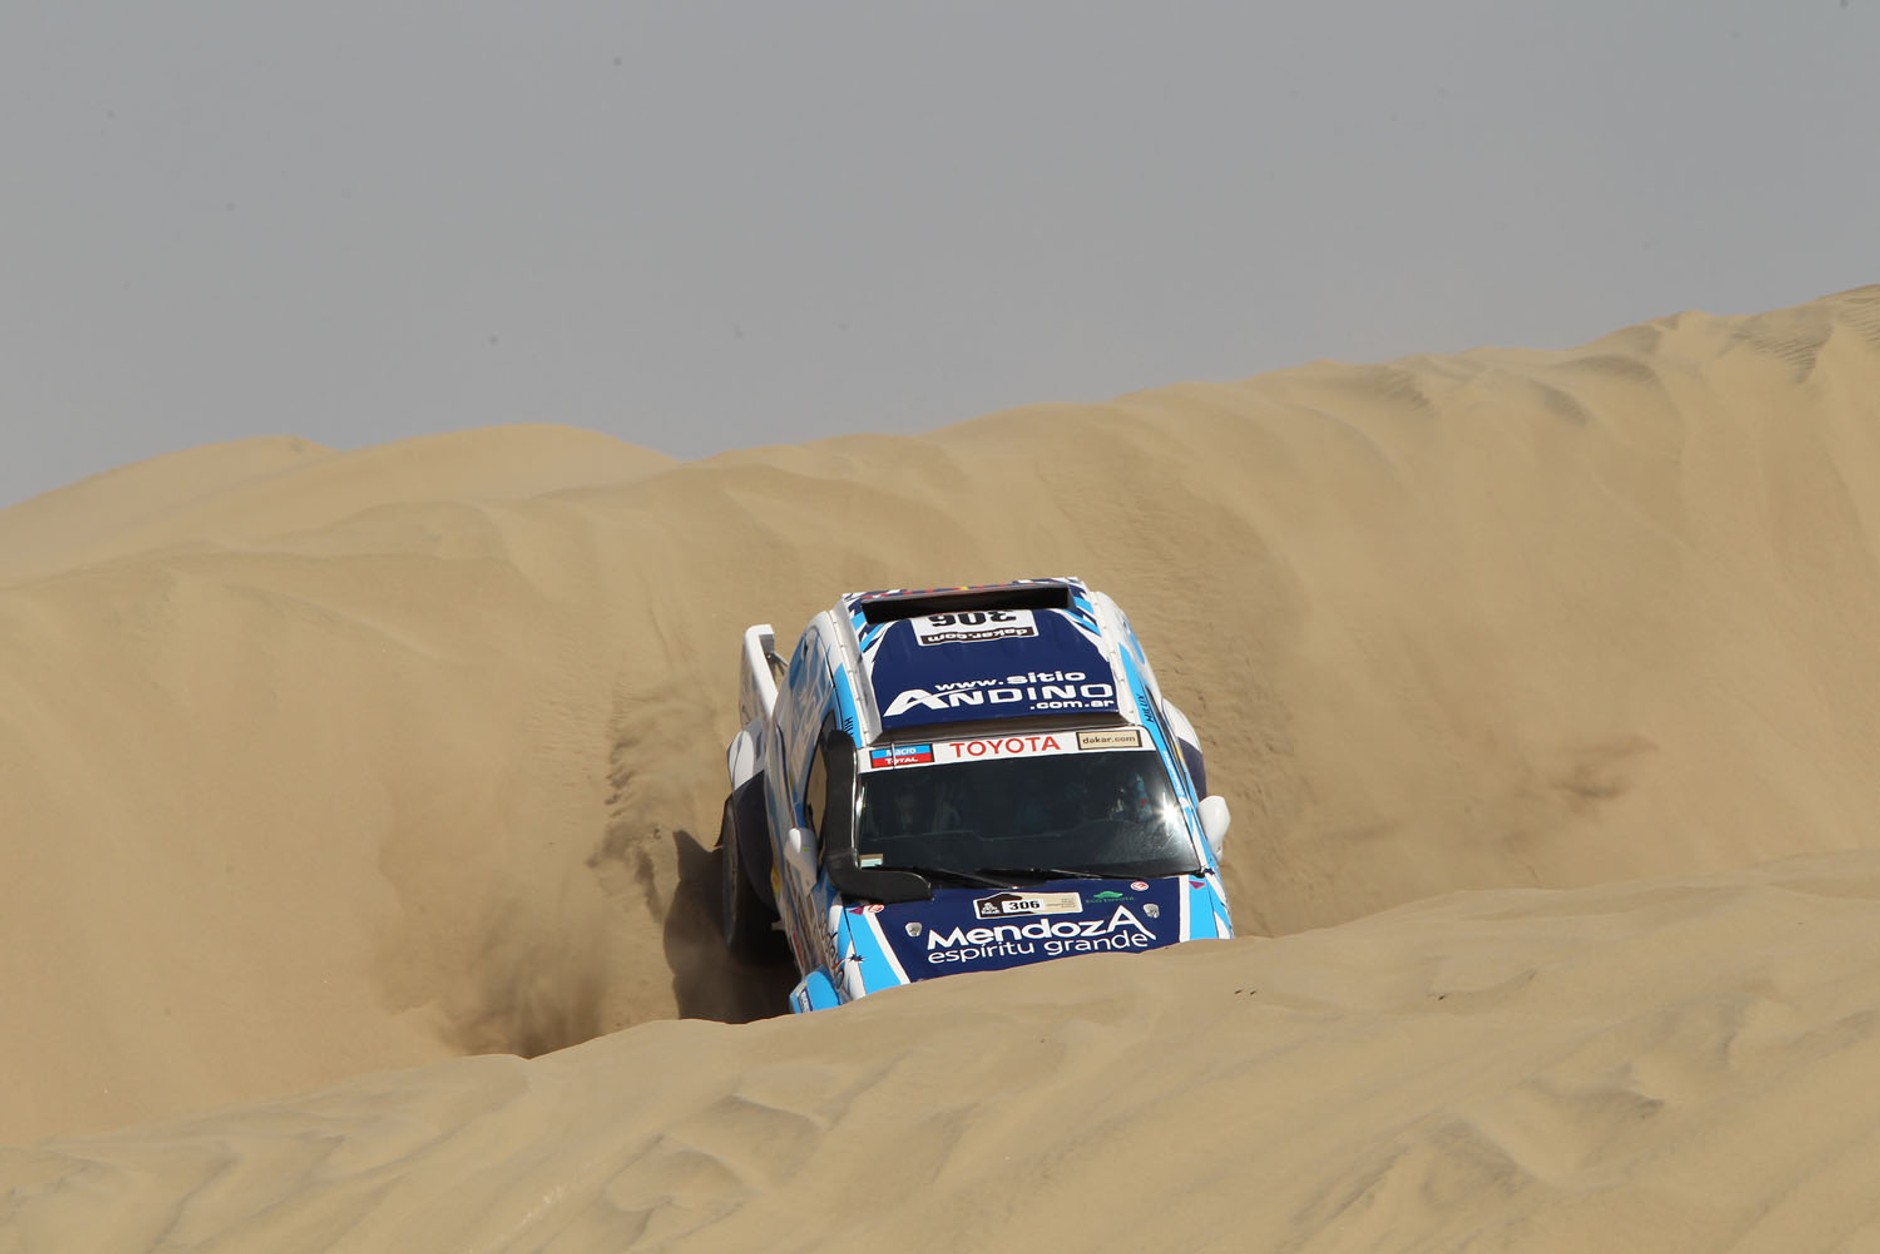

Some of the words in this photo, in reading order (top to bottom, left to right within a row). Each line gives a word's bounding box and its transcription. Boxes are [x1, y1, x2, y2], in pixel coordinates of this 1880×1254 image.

[927, 628, 1028, 642] dakar.com
[934, 671, 1087, 692] www.sitio
[883, 683, 1114, 717] ANDINO
[1029, 699, 1115, 711] .com.ar
[950, 736, 1061, 759] TOYOTA
[1082, 736, 1136, 744] dakar.com
[1008, 900, 1040, 910] 306
[928, 940, 1034, 964] espíritu
[1044, 931, 1148, 956] grande
